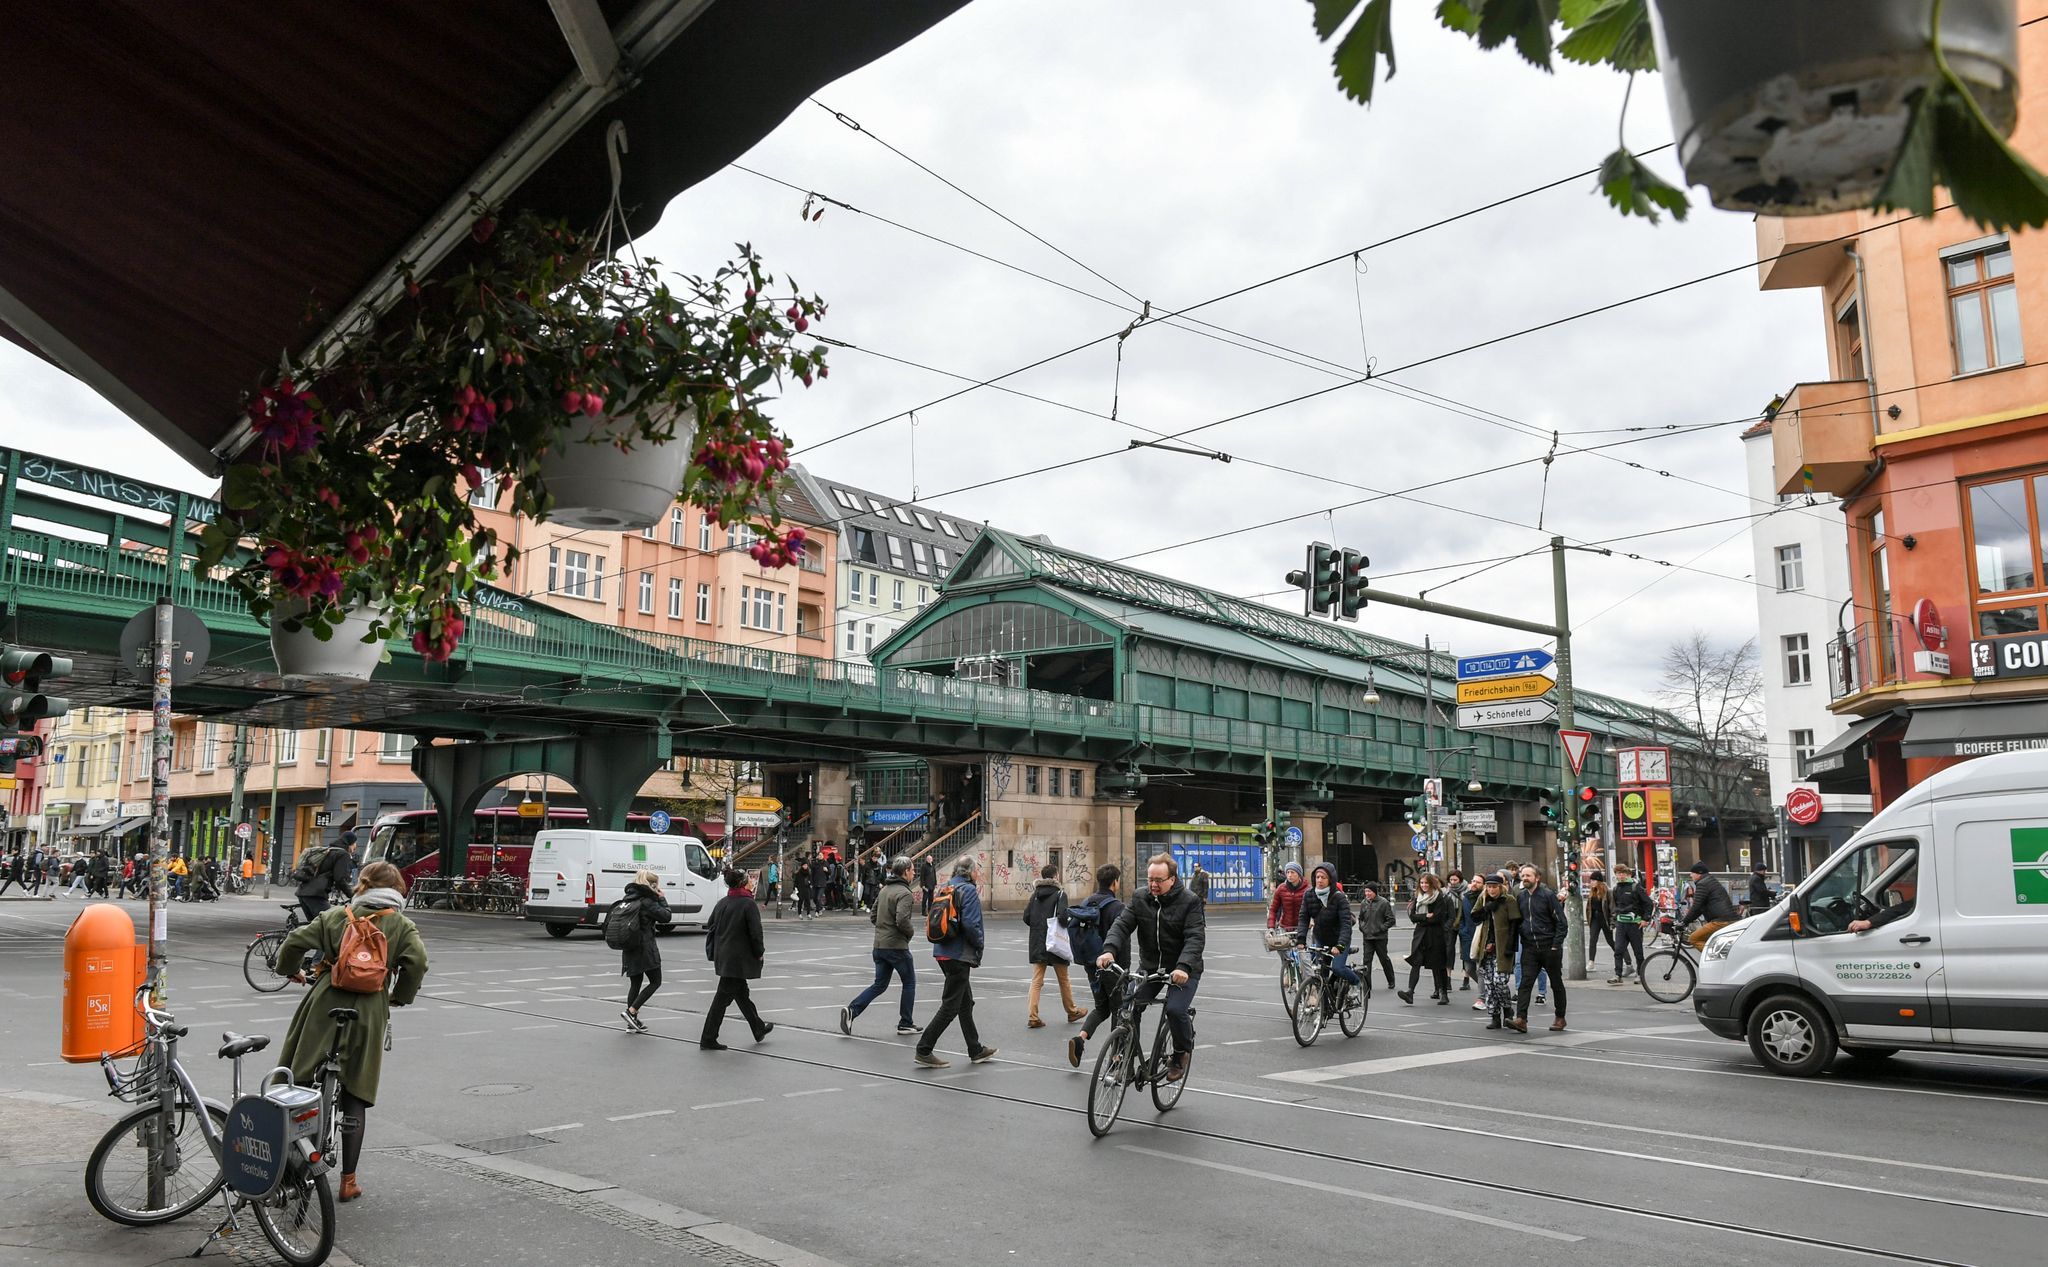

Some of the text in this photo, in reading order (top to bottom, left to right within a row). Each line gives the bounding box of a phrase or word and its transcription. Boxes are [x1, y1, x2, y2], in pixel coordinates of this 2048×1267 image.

[1497, 660, 1507, 668] 117
[1974, 665, 1994, 673] COFFEE
[1464, 684, 1520, 697] Friedrichshain
[1486, 708, 1531, 720] Schönefeld
[1964, 741, 2004, 754] COFFEE
[874, 812, 911, 821] Eberswalder
[1835, 962, 1911, 972] enterprise.de
[1836, 972, 1912, 980] 0800 3722826
[89, 999, 108, 1013] BSR
[245, 1136, 272, 1163] DEEZER
[240, 1163, 269, 1180] nextbike
